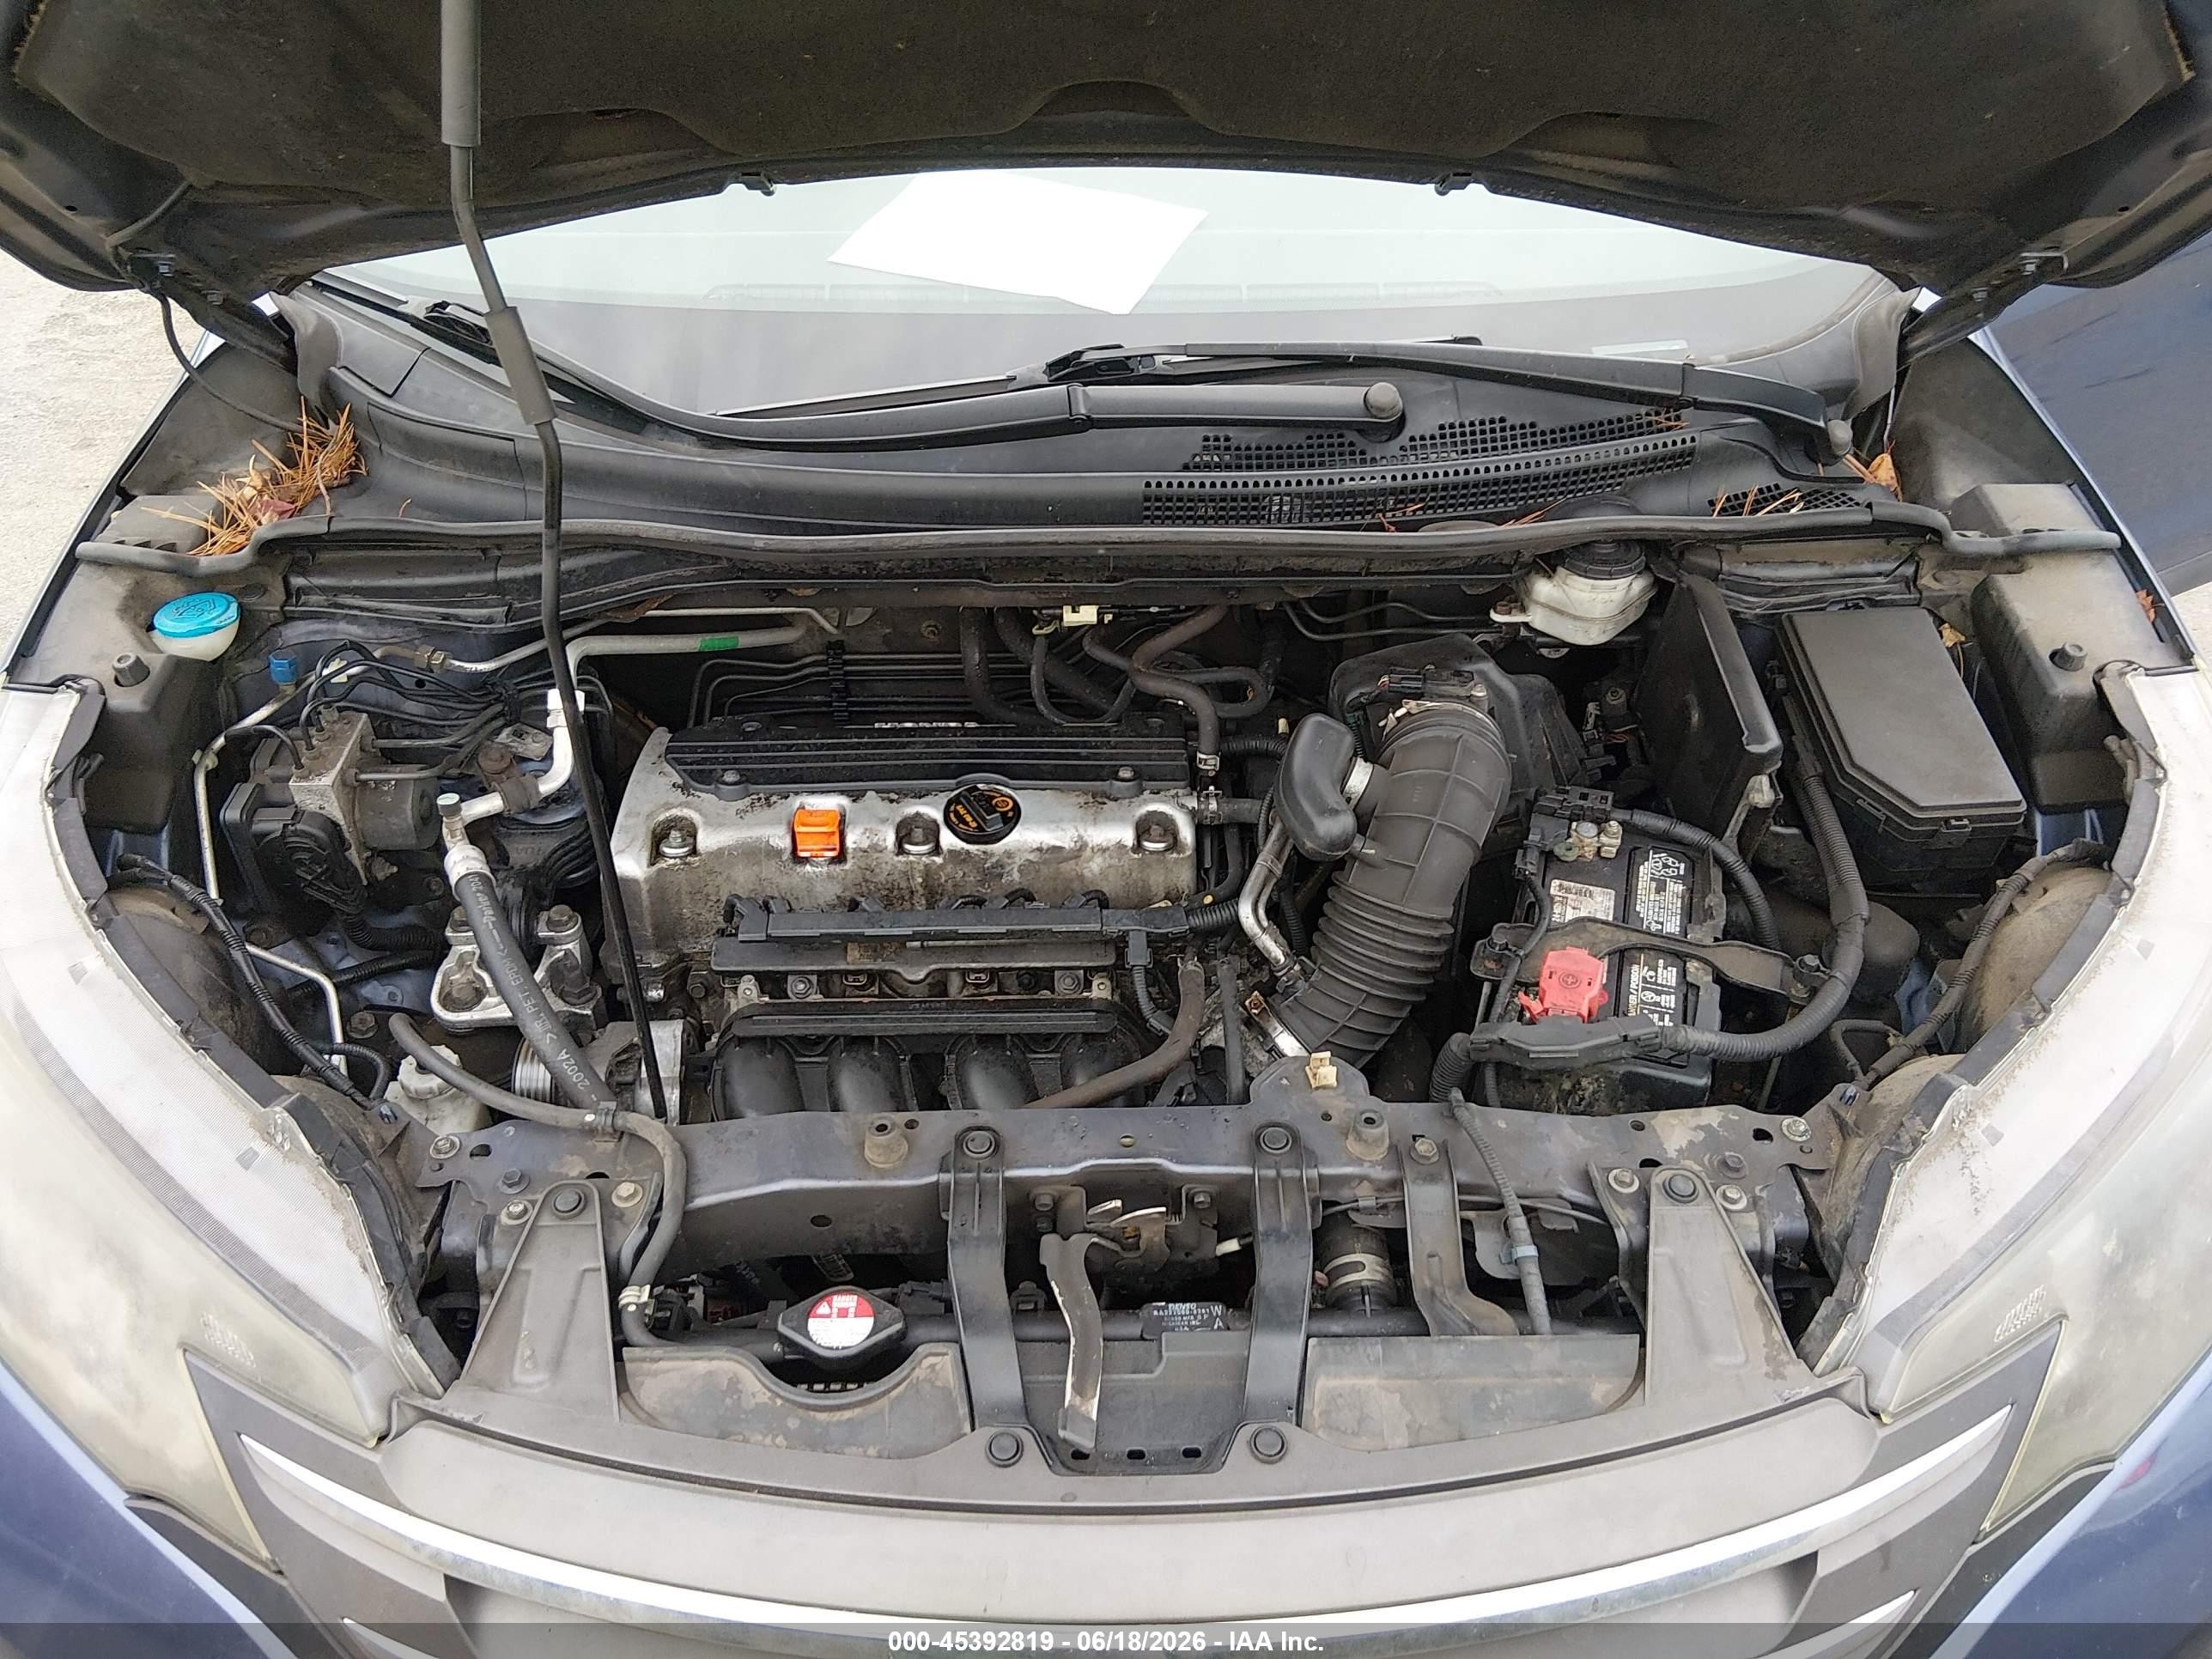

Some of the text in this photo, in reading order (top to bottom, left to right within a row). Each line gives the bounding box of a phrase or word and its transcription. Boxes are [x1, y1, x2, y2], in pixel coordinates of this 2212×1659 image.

[556, 1048, 591, 1090] 2002A
[1210, 1304, 1223, 1316] W
[1213, 1316, 1224, 1330] A
